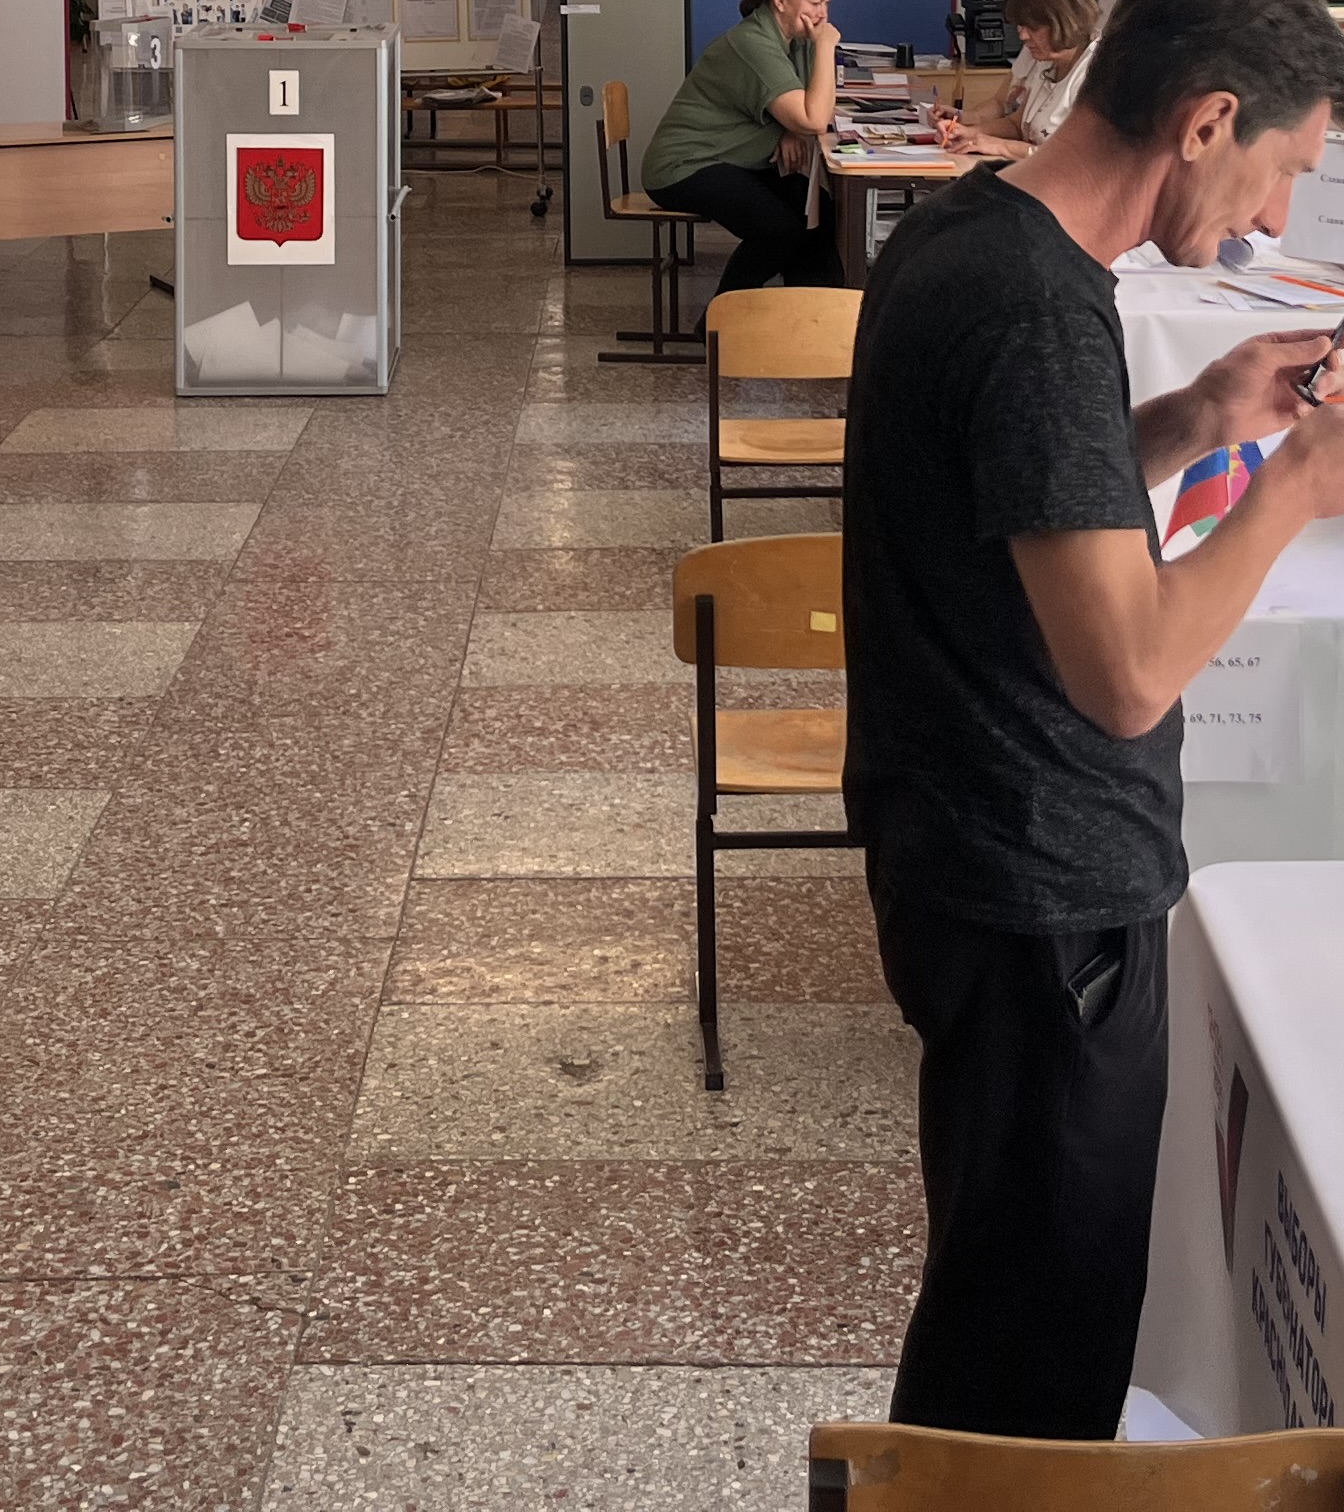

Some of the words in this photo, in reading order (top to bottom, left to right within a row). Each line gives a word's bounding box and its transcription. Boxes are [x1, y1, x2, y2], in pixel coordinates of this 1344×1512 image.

[150, 38, 161, 70] 3
[280, 81, 289, 106] 1
[1228, 657, 1244, 668] 65,
[1247, 657, 1260, 667] 67
[1189, 713, 1206, 724] 69,
[1209, 713, 1227, 724] 71,
[1229, 713, 1245, 724] 73,
[1248, 713, 1262, 724] 75
[1277, 1170, 1327, 1334] ВЫБОРЫ
